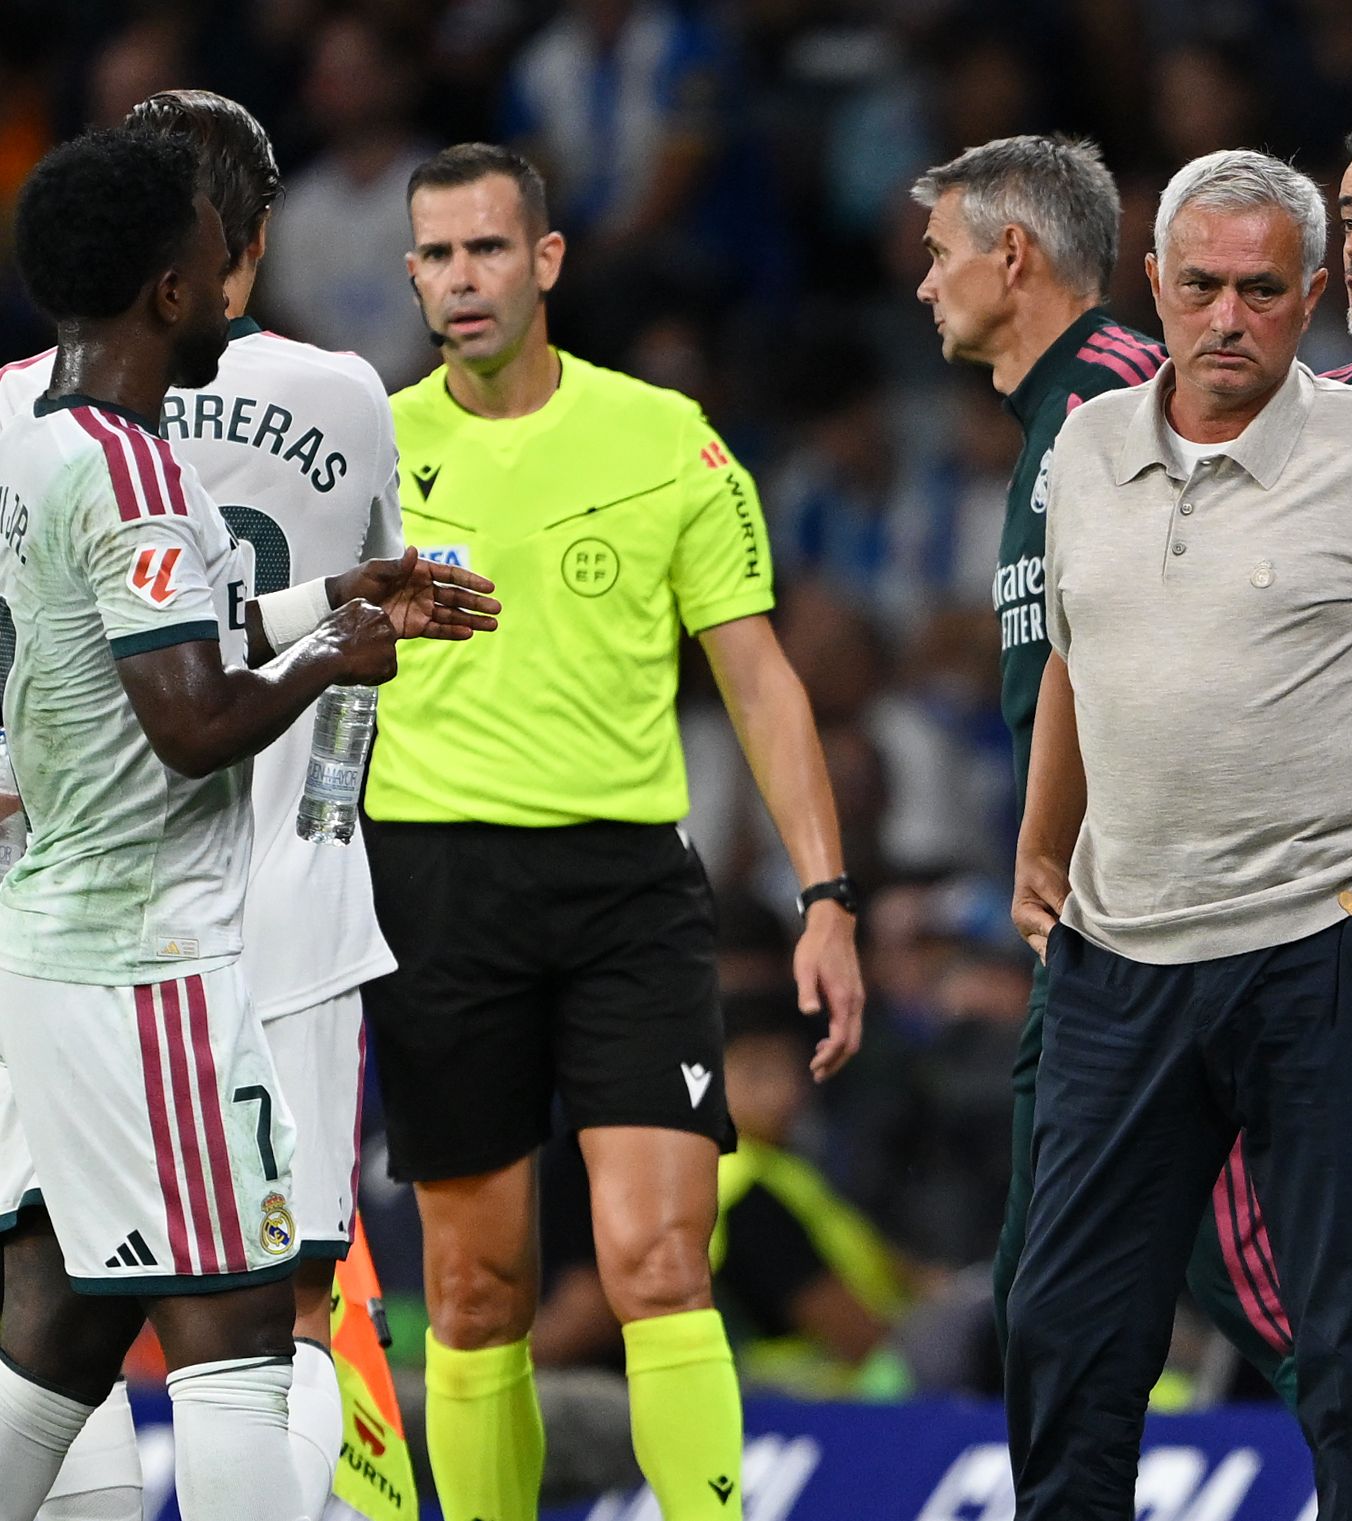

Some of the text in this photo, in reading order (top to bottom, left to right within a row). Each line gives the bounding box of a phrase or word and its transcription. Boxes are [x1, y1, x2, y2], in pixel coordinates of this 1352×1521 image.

[159, 393, 348, 493] RRERAS
[1001, 602, 1044, 651] ETTER
[232, 1084, 278, 1182] 7
